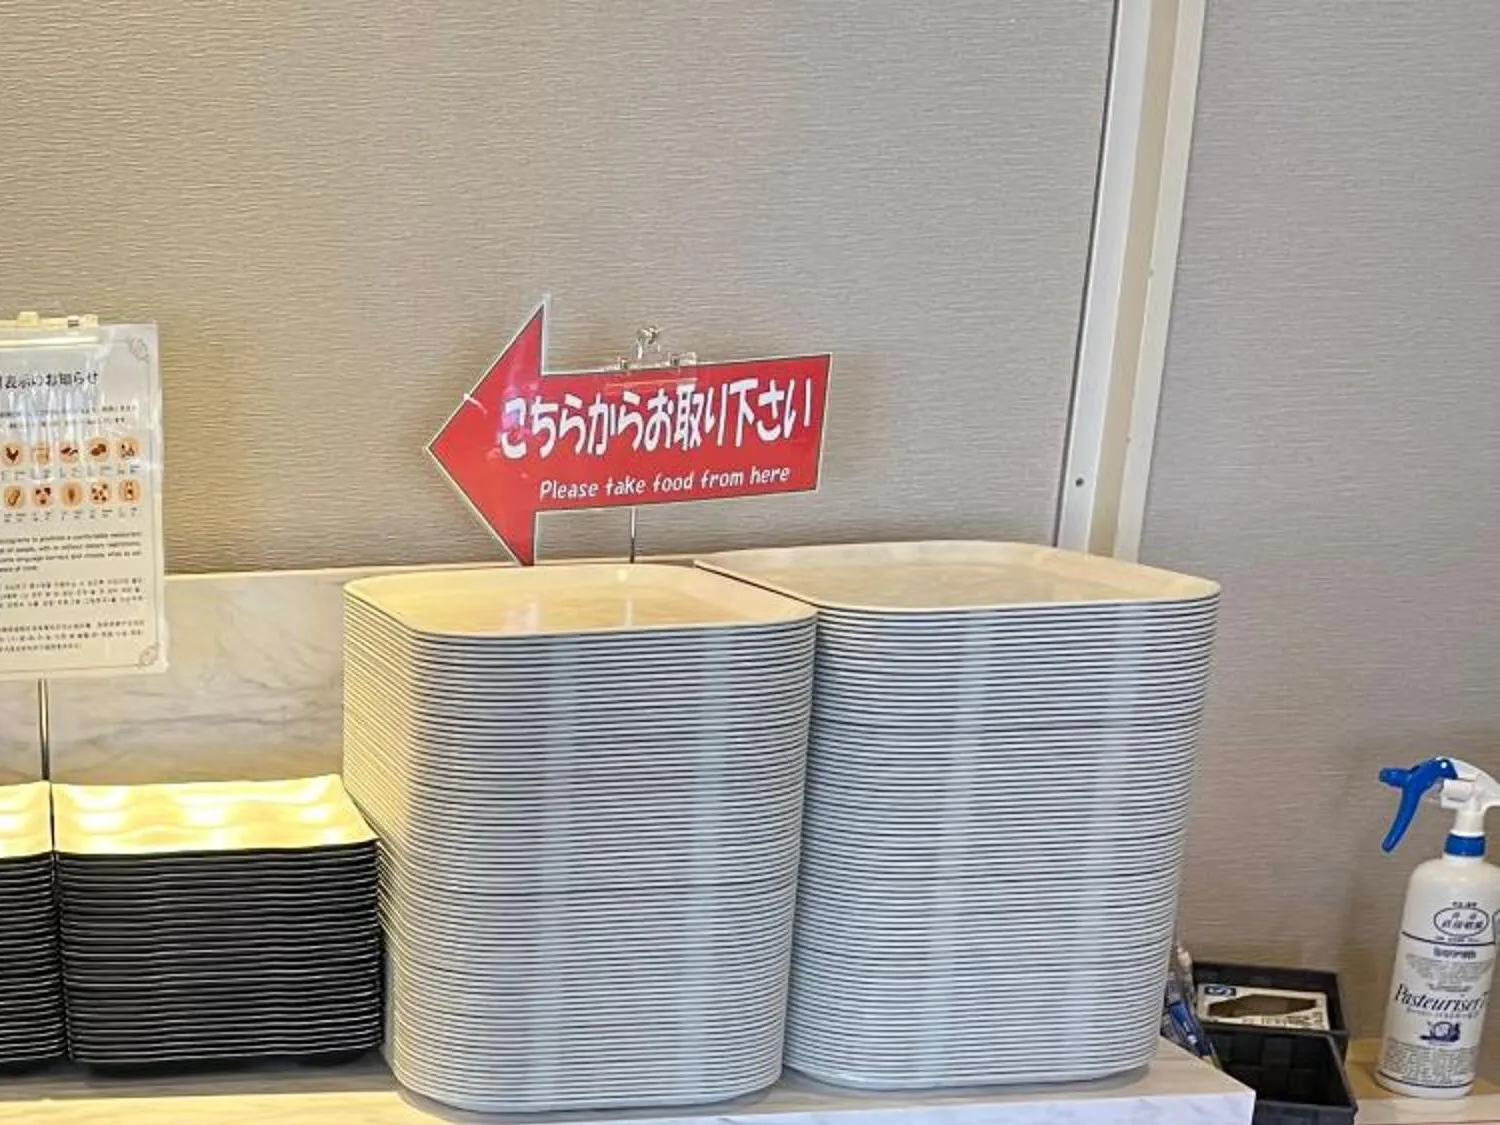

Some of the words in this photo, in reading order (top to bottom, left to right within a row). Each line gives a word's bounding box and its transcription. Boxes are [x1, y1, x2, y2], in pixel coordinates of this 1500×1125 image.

[500, 376, 812, 460] こちらからお取り下さい
[538, 479, 599, 501] Please
[605, 476, 646, 496] take
[652, 472, 694, 493] food
[700, 469, 744, 490] from
[749, 465, 791, 484] here
